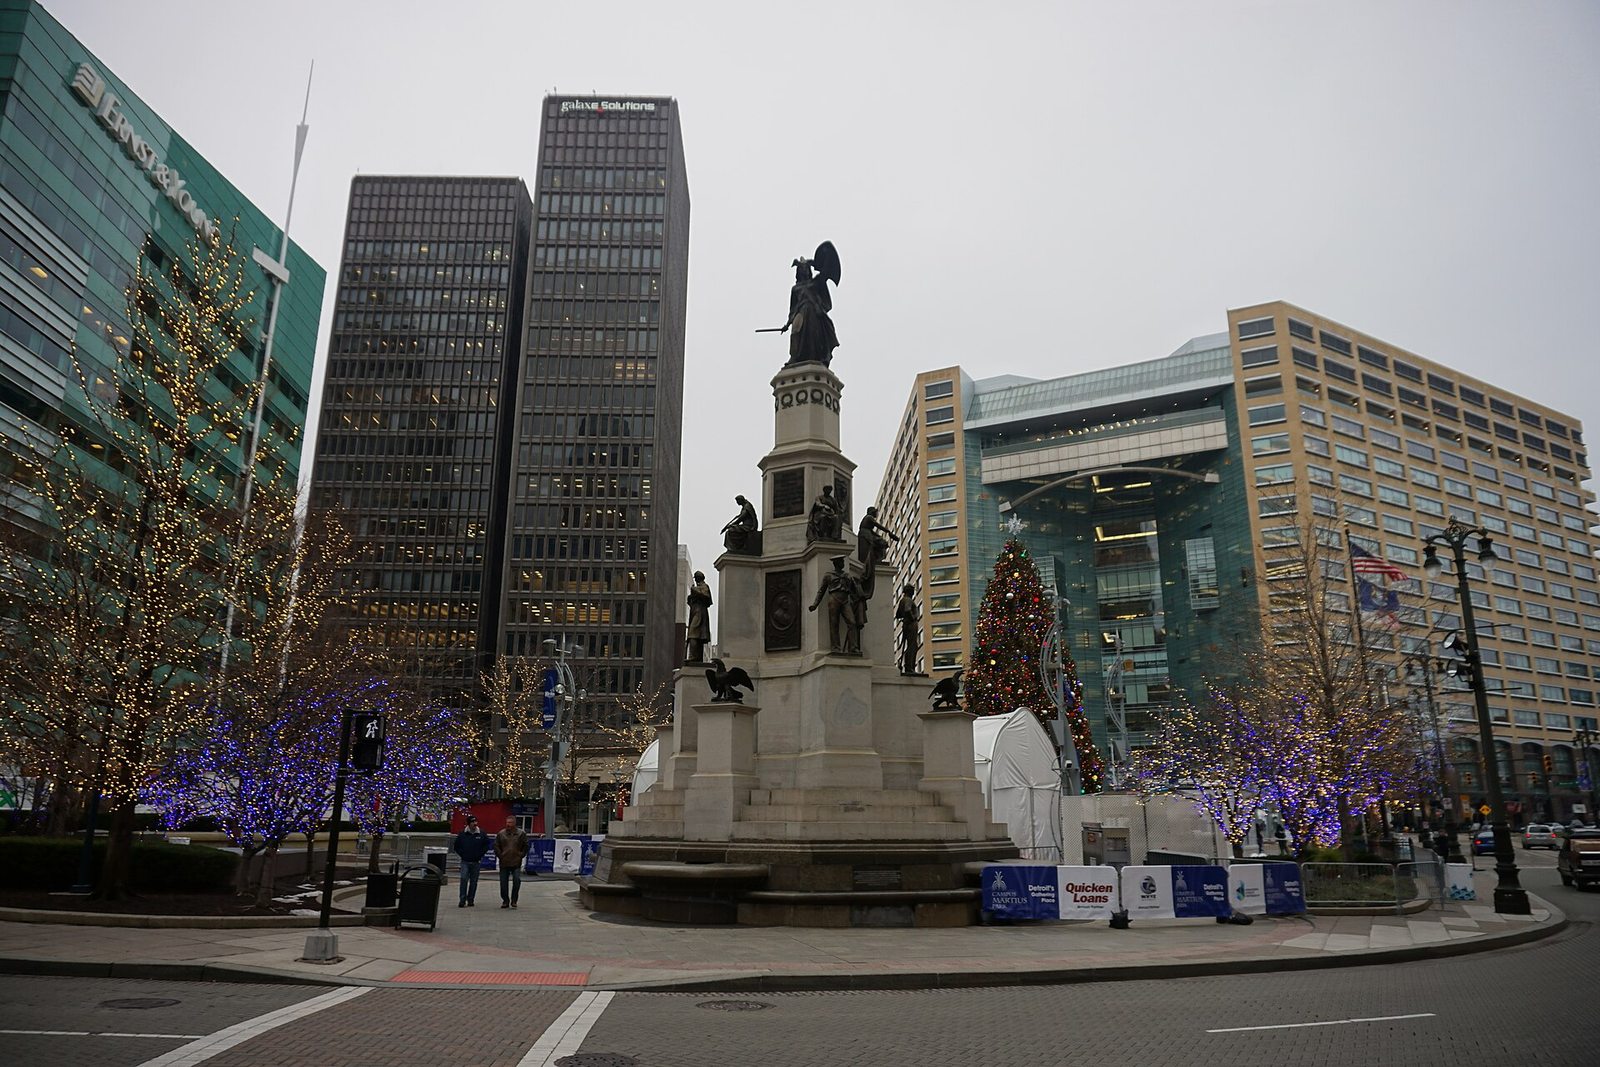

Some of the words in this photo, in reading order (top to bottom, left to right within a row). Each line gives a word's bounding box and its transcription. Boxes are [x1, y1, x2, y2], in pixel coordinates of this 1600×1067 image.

[601, 101, 655, 111] Solutions
[97, 92, 159, 170] ERNST
[152, 163, 170, 190] &
[1065, 882, 1113, 894] Quicken
[1073, 893, 1109, 903] Loans
